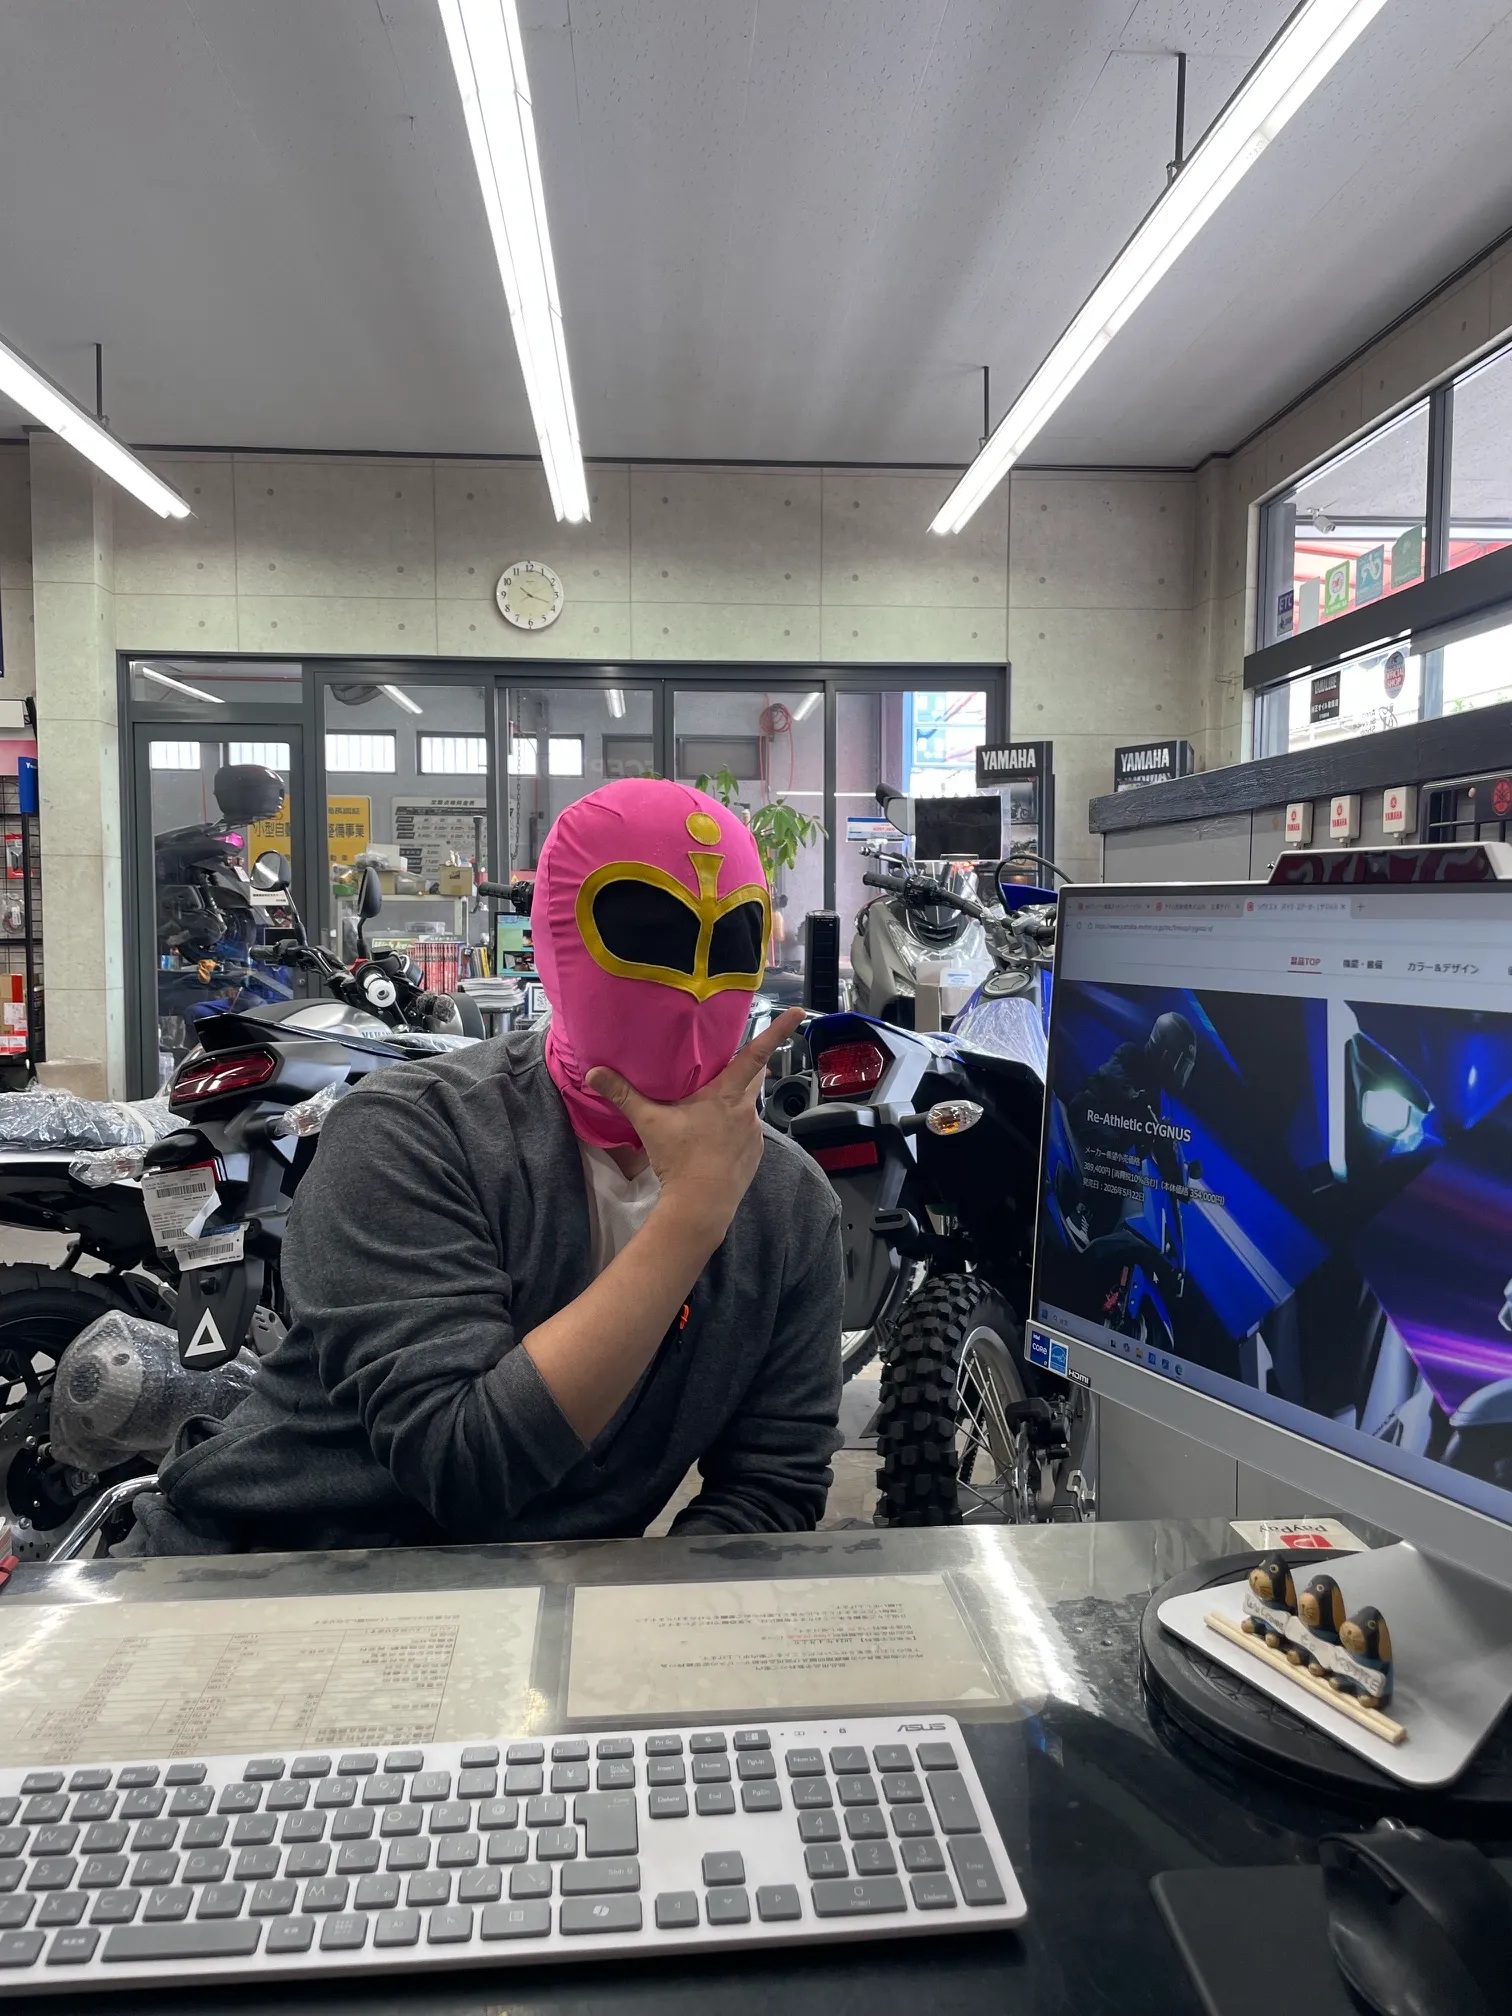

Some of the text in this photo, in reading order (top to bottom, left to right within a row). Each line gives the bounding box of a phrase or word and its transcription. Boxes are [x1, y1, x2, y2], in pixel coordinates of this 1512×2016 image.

[982, 749, 1036, 770] YAMAHA
[1121, 748, 1170, 772] YAMAHA
[1385, 811, 1402, 821] YAMAHA
[1332, 818, 1347, 827] YAMAHA
[1087, 1110, 1191, 1142] Re-Athletic CYGNUS
[1085, 1146, 1140, 1166] メーカー希望小売価格
[1084, 1162, 1110, 1176] 389,400円
[1260, 1524, 1328, 1533] PayPay
[897, 1722, 946, 1732] ASUS
[40, 1831, 57, 1842] W
[243, 1855, 256, 1865] H
[259, 1888, 272, 1900] N
[308, 1886, 325, 1897] M
[156, 1894, 167, 1906] V
